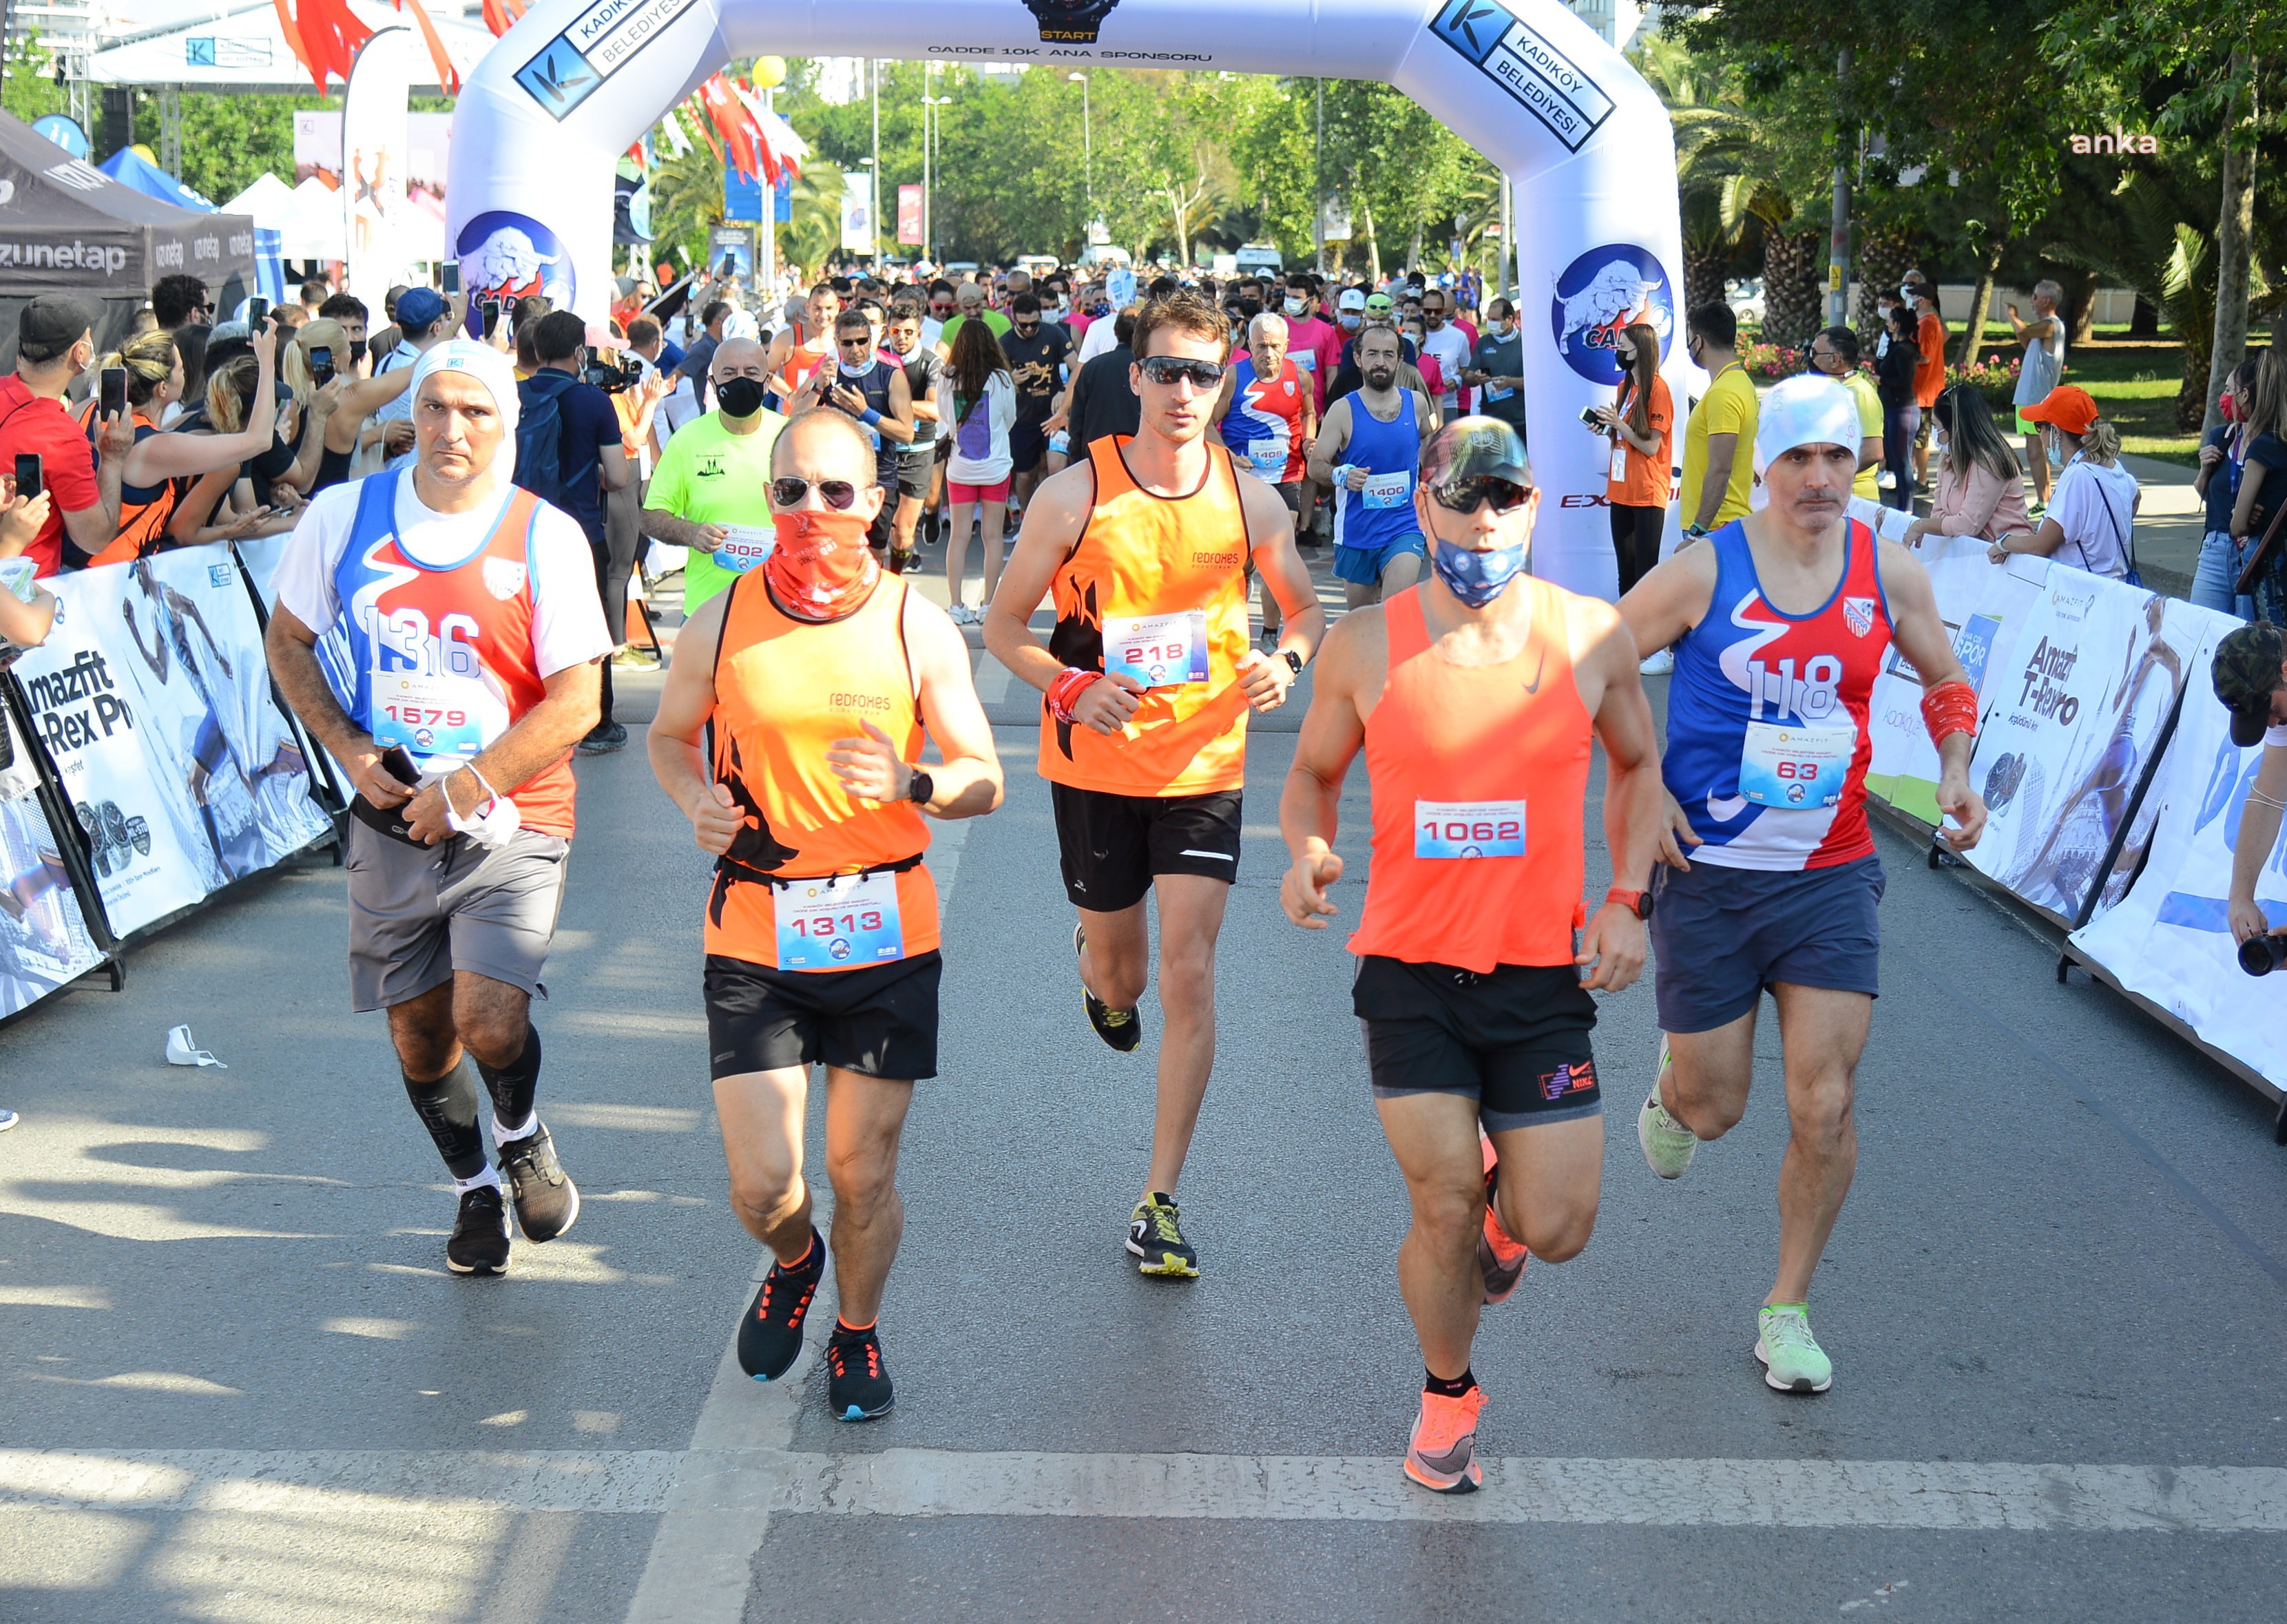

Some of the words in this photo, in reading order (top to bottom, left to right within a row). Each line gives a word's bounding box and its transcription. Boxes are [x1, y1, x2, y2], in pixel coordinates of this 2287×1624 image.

[1041, 30, 1096, 41] START
[928, 46, 994, 54] CADDE
[1002, 48, 1041, 56] 10K
[1049, 49, 1092, 57] ANA
[1100, 51, 1213, 62] SPONSORU
[1516, 37, 1583, 94] KADIKÖY
[1496, 60, 1580, 134] BELEDİYESİ
[156, 238, 184, 269] uzunetap
[1369, 486, 1404, 497] 1400
[724, 543, 762, 557] 902
[364, 605, 481, 678] 136
[1125, 643, 1183, 664] 218
[1746, 654, 1842, 720] 118
[385, 705, 466, 727] 1579
[1777, 761, 1818, 780] 63
[1423, 822, 1520, 841] 1062
[792, 911, 882, 937] 1313
